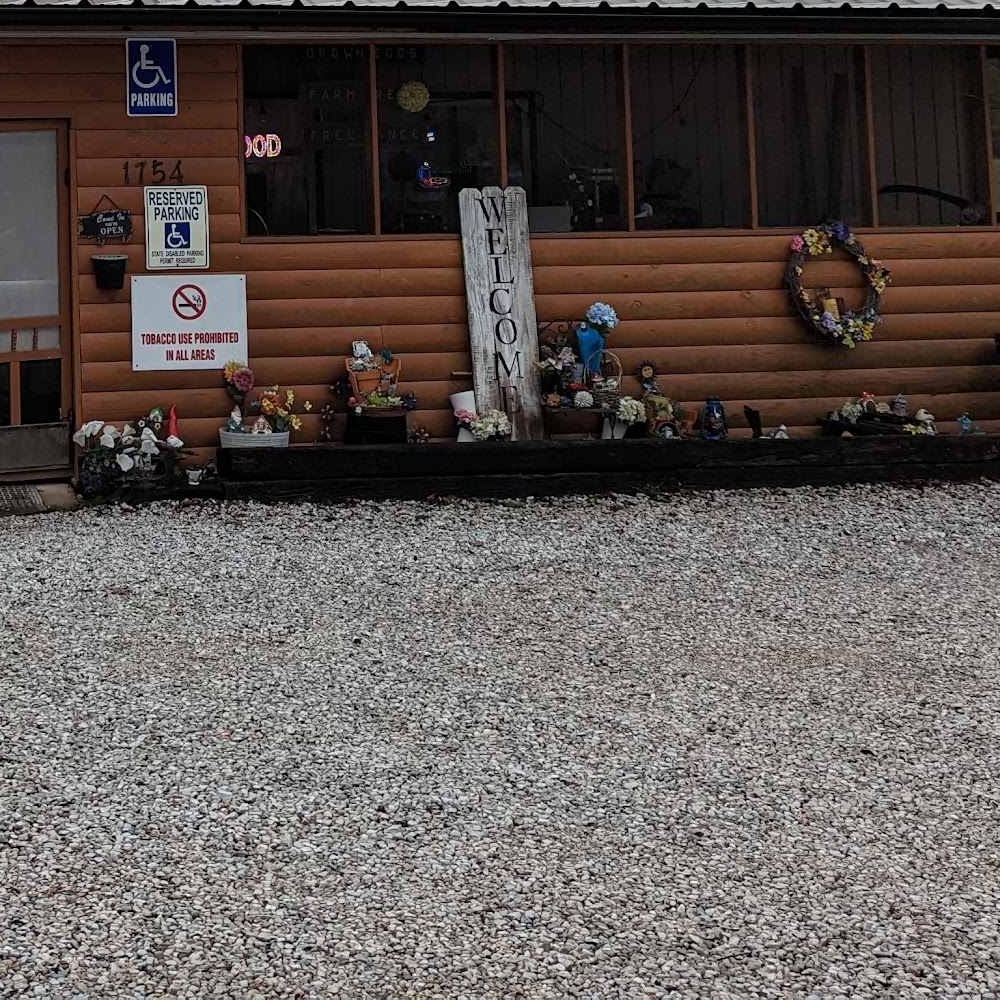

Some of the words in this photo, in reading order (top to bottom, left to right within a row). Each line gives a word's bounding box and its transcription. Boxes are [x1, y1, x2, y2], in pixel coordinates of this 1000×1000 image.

[130, 93, 174, 107] PARKING
[244, 133, 281, 158] OOD
[122, 159, 184, 184] 1754
[149, 191, 202, 206] RESERVED
[96, 213, 115, 223] Come
[154, 206, 199, 221] PARKING
[100, 226, 124, 235] OPEN
[474, 196, 524, 414] WELCOME
[141, 333, 177, 345] TOBACCO
[179, 333, 192, 345] USE
[194, 332, 239, 344] PROHIBITED
[166, 350, 174, 361] IN
[175, 349, 189, 361] ALL
[191, 349, 215, 361] AREAS
